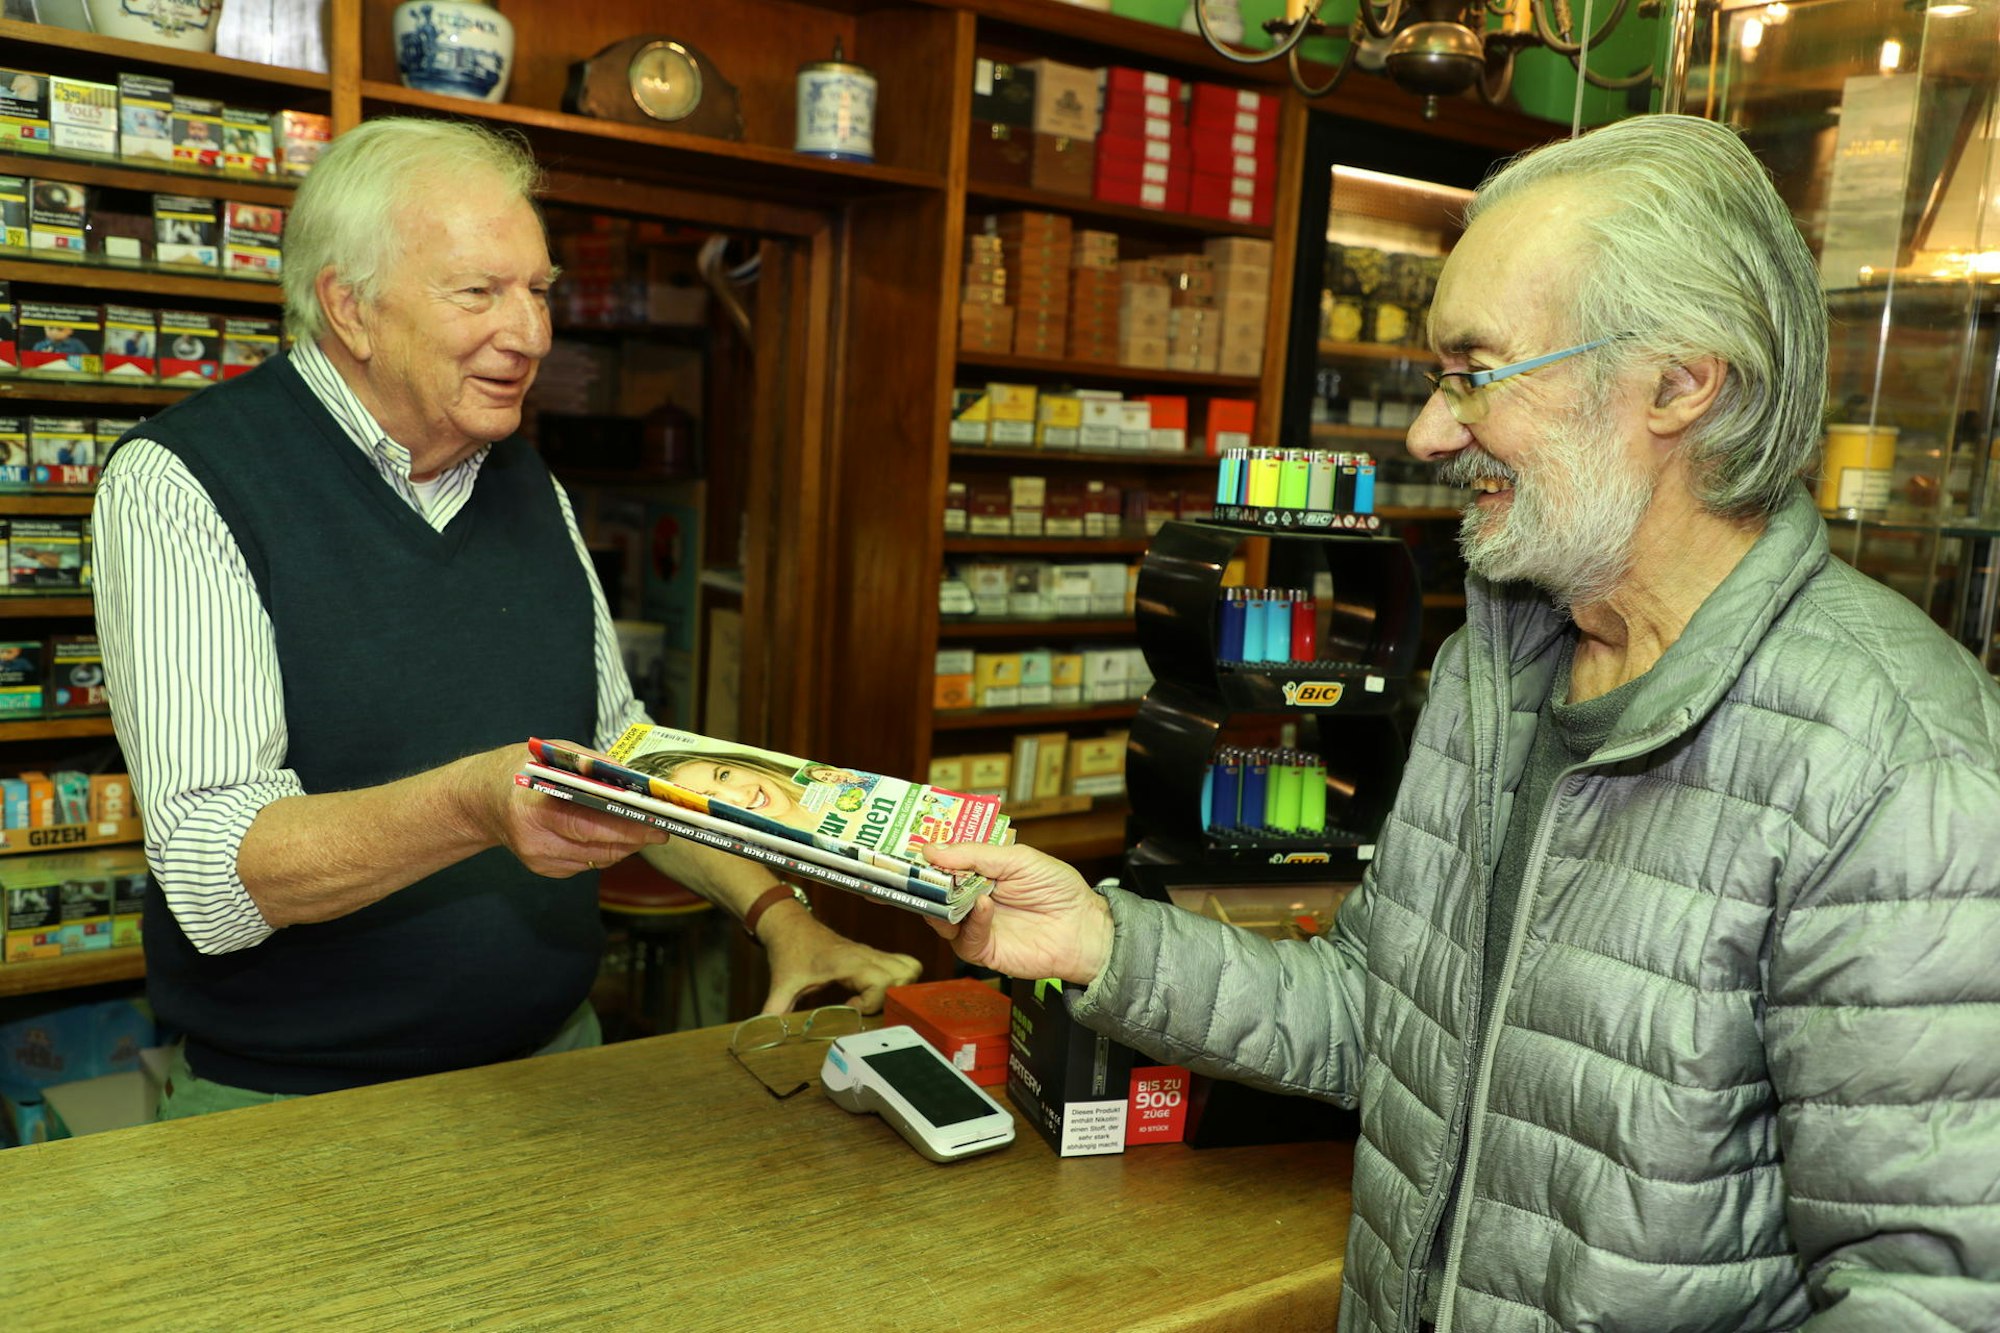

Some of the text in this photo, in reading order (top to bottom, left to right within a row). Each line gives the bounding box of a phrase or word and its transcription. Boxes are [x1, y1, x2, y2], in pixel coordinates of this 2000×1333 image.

[606, 804, 645, 821] EAGLE FIELD
[667, 823, 694, 835] CAPRICE
[29, 827, 87, 847] GIZEH
[695, 832, 732, 848] CHEVROLET
[743, 846, 787, 864] EDSEL PACER
[797, 864, 824, 877] US-CARS
[872, 886, 892, 897] F-150
[892, 891, 911, 902] FORD
[1138, 1079, 1181, 1092] BIS ZU
[1135, 1091, 1181, 1110] 900
[1142, 1109, 1170, 1119] ZÜGE
